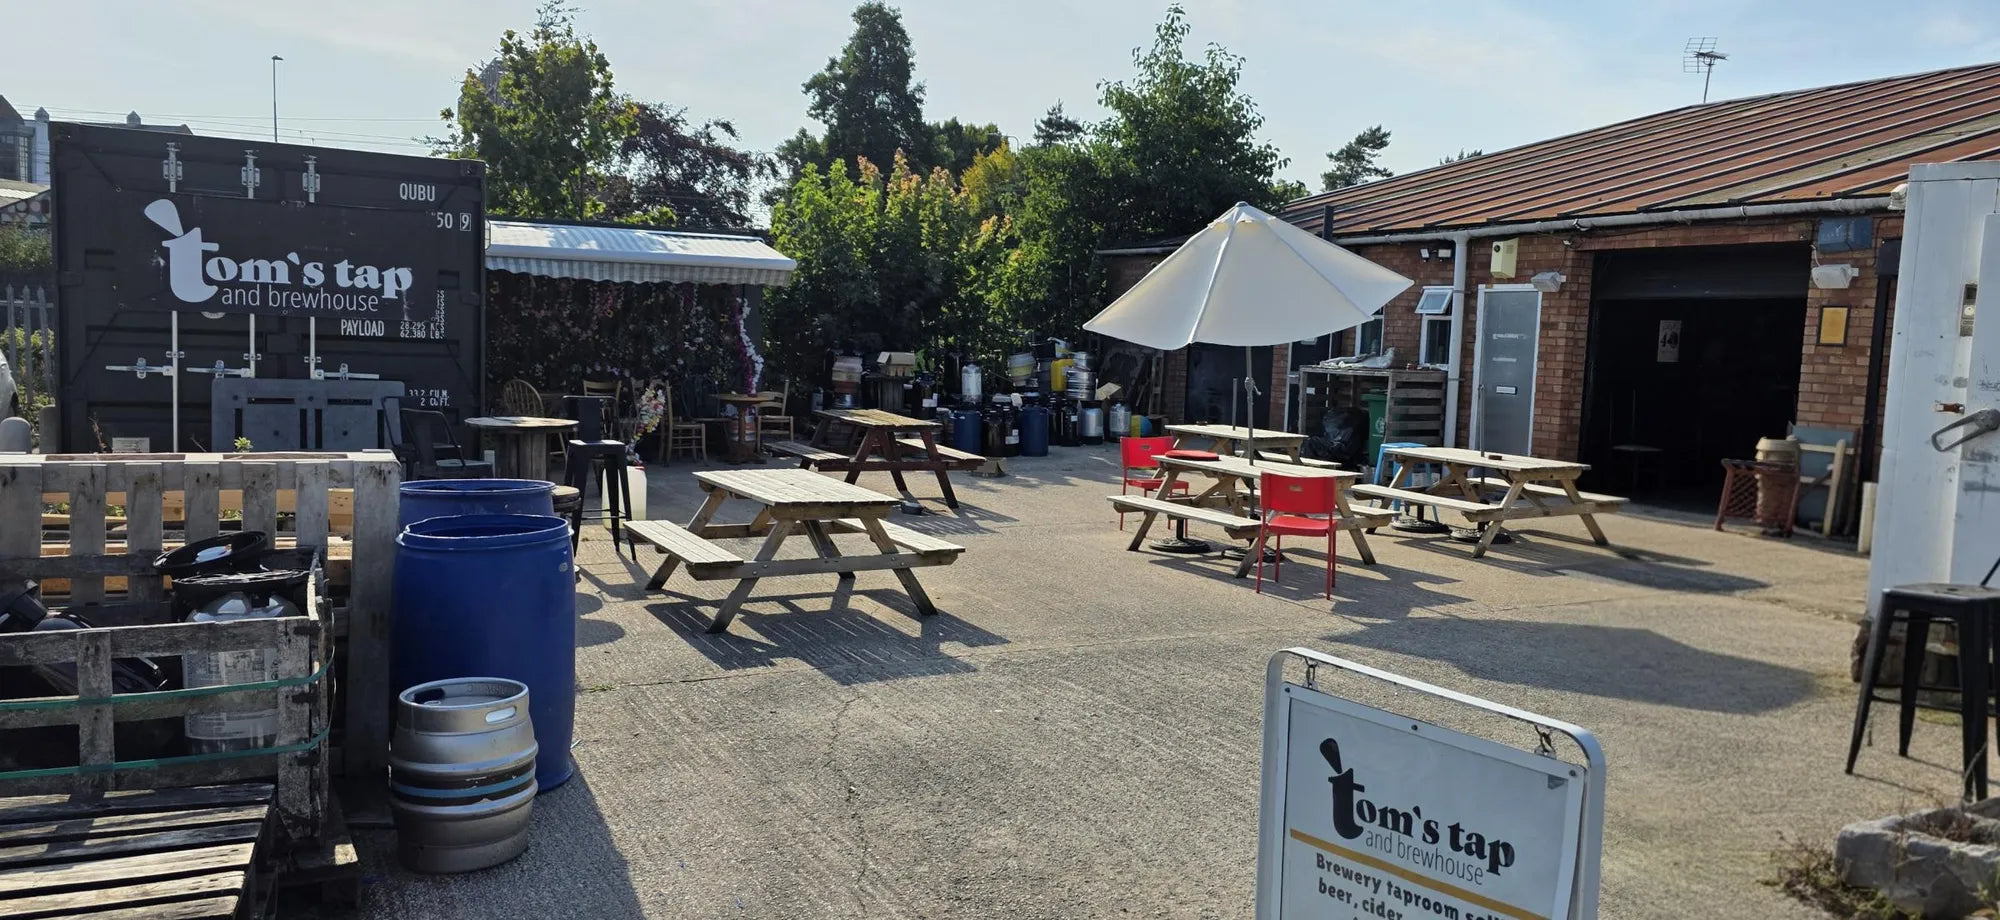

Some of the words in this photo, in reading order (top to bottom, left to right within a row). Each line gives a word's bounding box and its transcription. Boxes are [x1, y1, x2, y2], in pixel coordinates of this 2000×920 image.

[400, 182, 435, 202] QUBU
[461, 213, 470, 230] 9
[161, 226, 325, 303] tom's
[333, 259, 413, 299] tap
[221, 285, 260, 306] and
[269, 285, 379, 312] brewhouse
[340, 319, 385, 337] PAYLOAD
[1328, 768, 1440, 845] tom's
[1448, 822, 1516, 876] tap
[1365, 829, 1393, 854] and
[1397, 835, 1484, 886] brewhouse
[1316, 852, 1382, 895] Brewery
[1386, 880, 1460, 920] taproom
